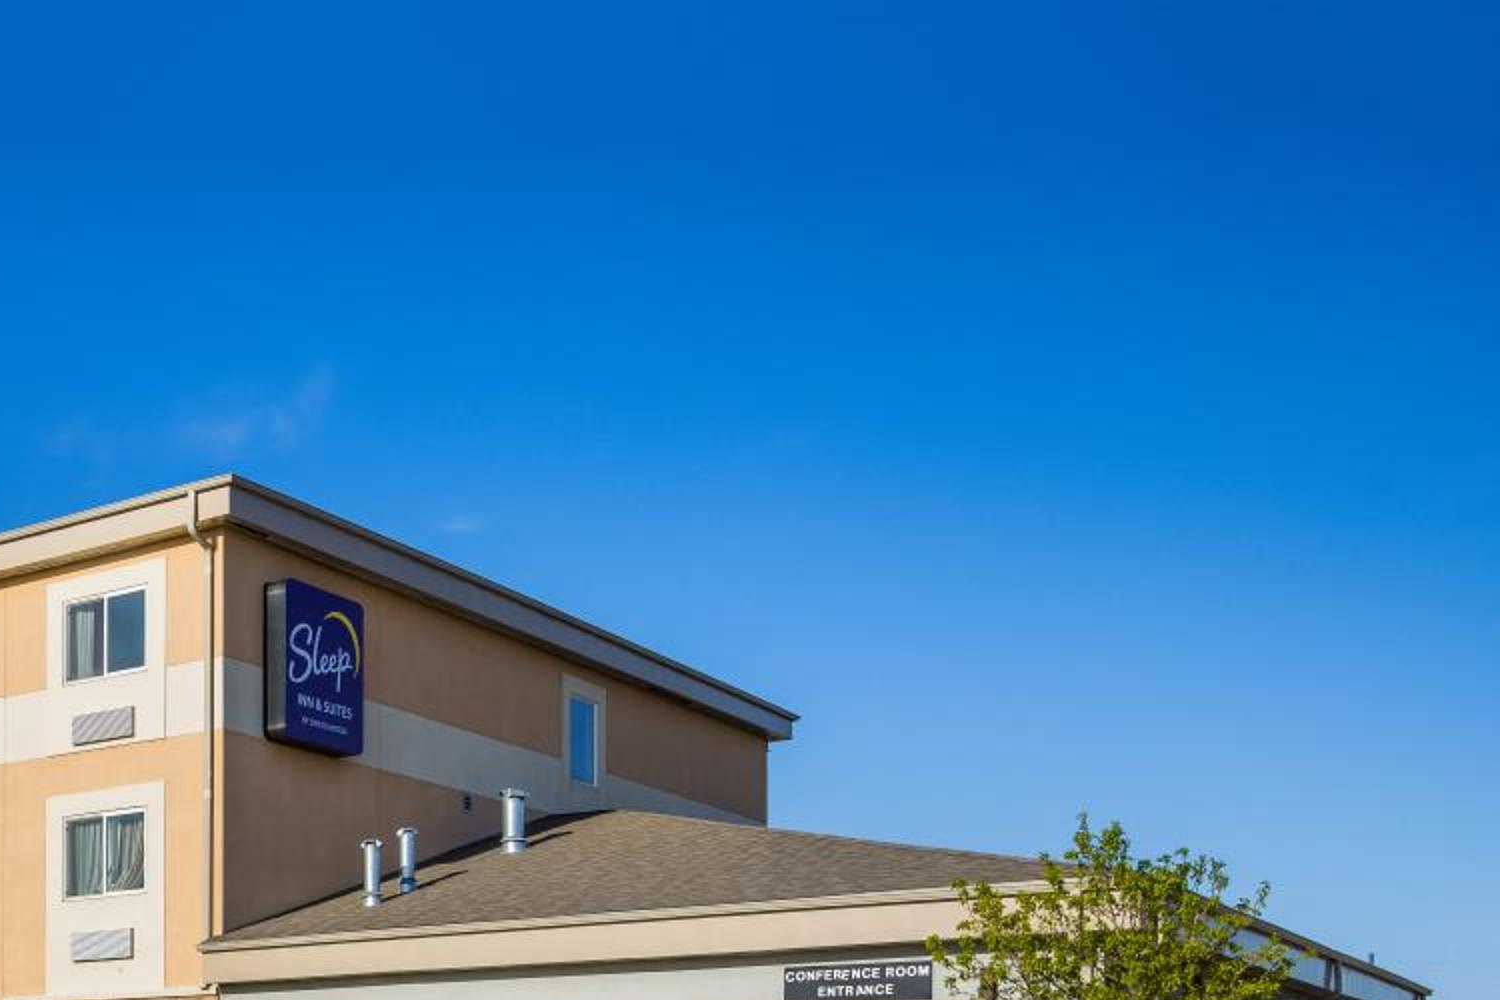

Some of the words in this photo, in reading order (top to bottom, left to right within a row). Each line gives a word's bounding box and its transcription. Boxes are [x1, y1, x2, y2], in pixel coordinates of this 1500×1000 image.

[289, 623, 353, 692] Sleep
[297, 692, 315, 709] INN
[315, 697, 323, 711] &
[323, 700, 353, 720] SUITES
[785, 967, 881, 983] CONFERENCE
[885, 965, 931, 978] ROOM
[817, 983, 895, 997] ENTRANCE
